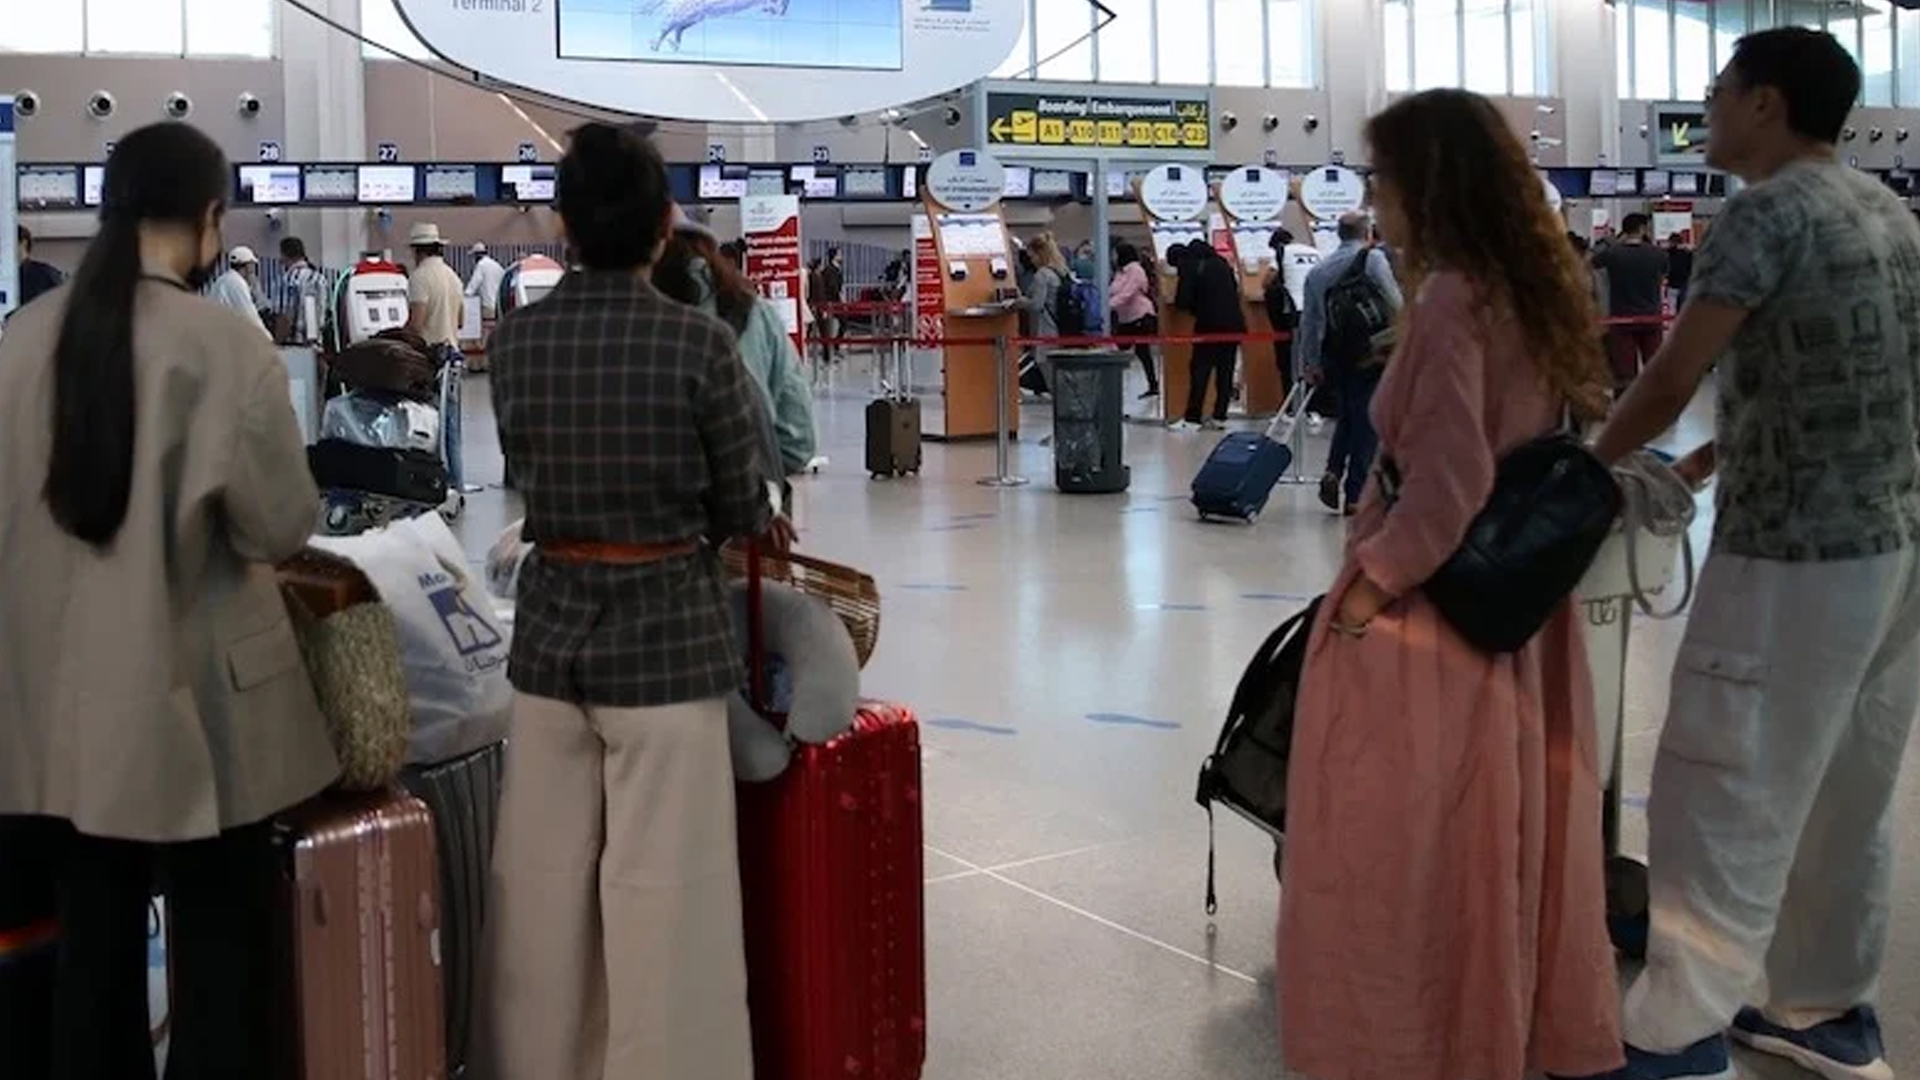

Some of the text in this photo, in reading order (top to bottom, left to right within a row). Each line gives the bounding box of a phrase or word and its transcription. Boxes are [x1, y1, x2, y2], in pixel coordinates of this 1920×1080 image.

[1038, 98, 1172, 118] Boarding Embarquement
[1043, 124, 1060, 137] A1
[1072, 125, 1094, 139] A10
[1100, 126, 1120, 139] B11
[1183, 127, 1206, 141] C23
[261, 146, 279, 160] 28
[380, 147, 397, 160] 27
